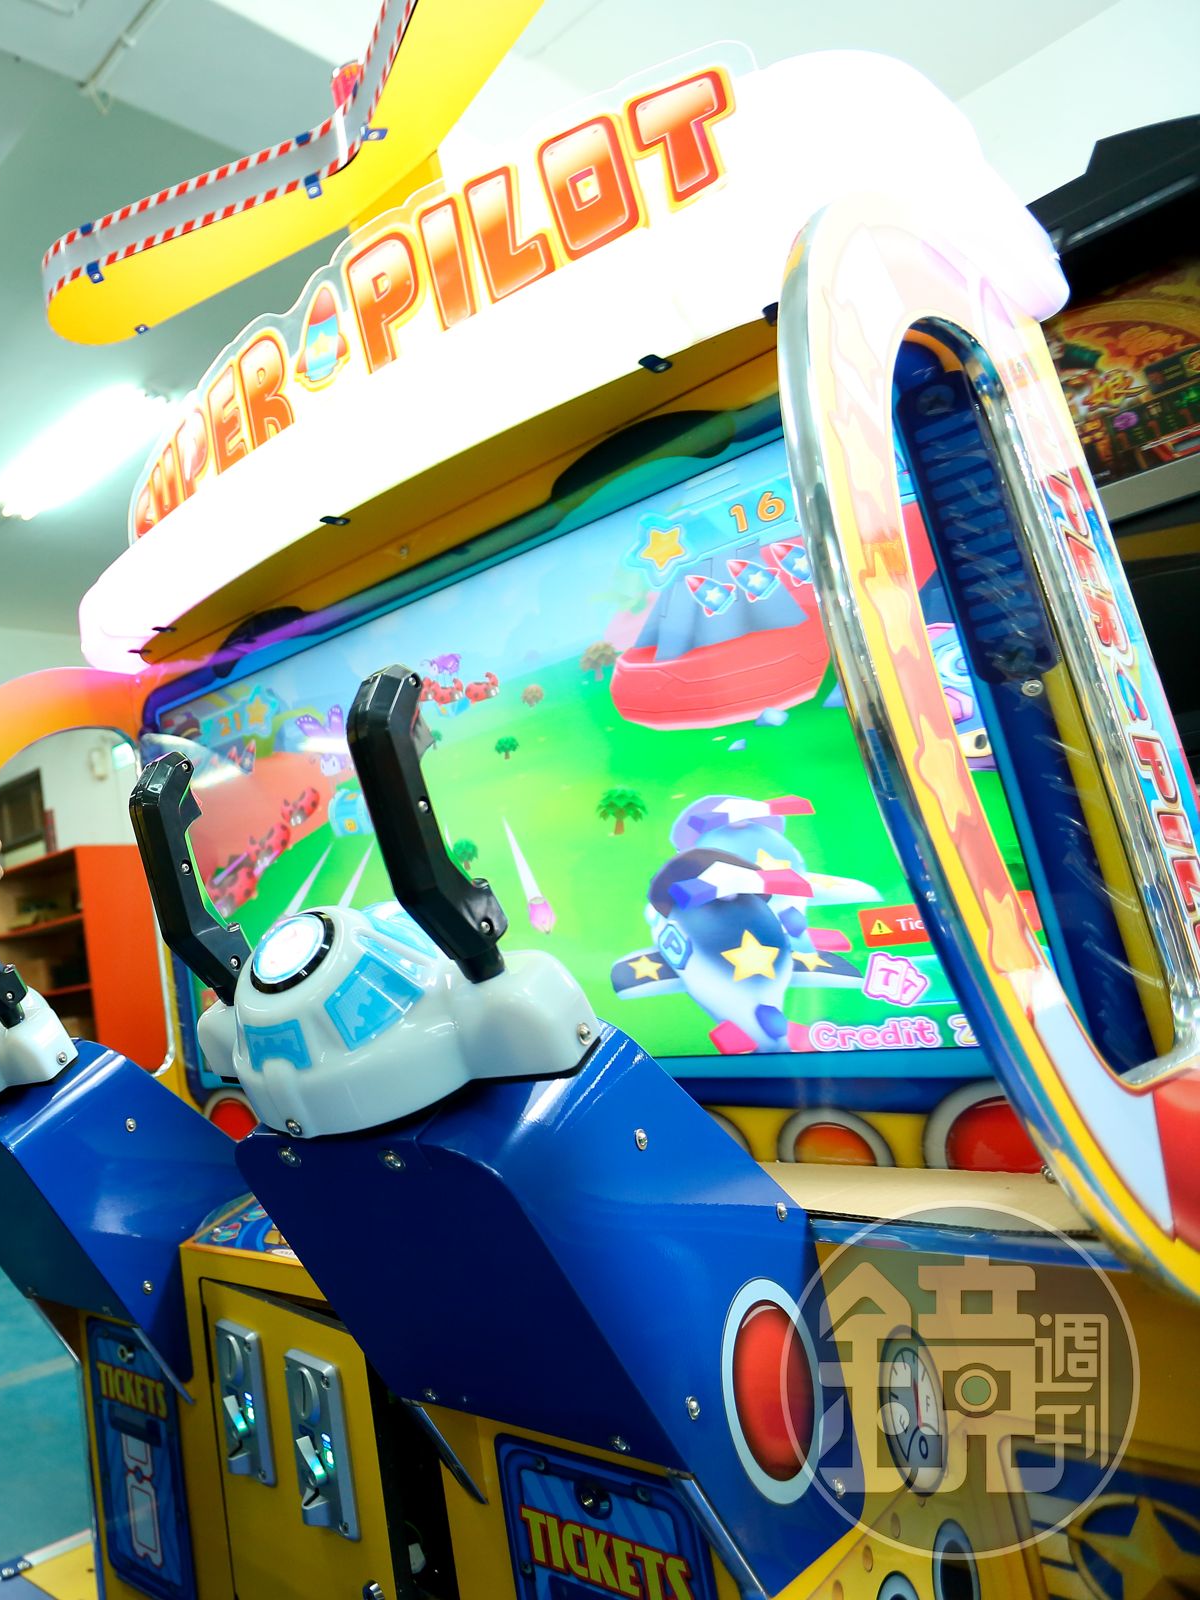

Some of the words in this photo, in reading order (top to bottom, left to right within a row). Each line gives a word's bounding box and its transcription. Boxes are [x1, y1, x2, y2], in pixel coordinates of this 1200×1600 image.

[343, 68, 732, 376] PILOT
[729, 491, 786, 534] 16
[218, 711, 242, 737] 21
[811, 1016, 939, 1049] Credit
[96, 1360, 168, 1420] TICKETS
[520, 1504, 694, 1600] TICKETS
